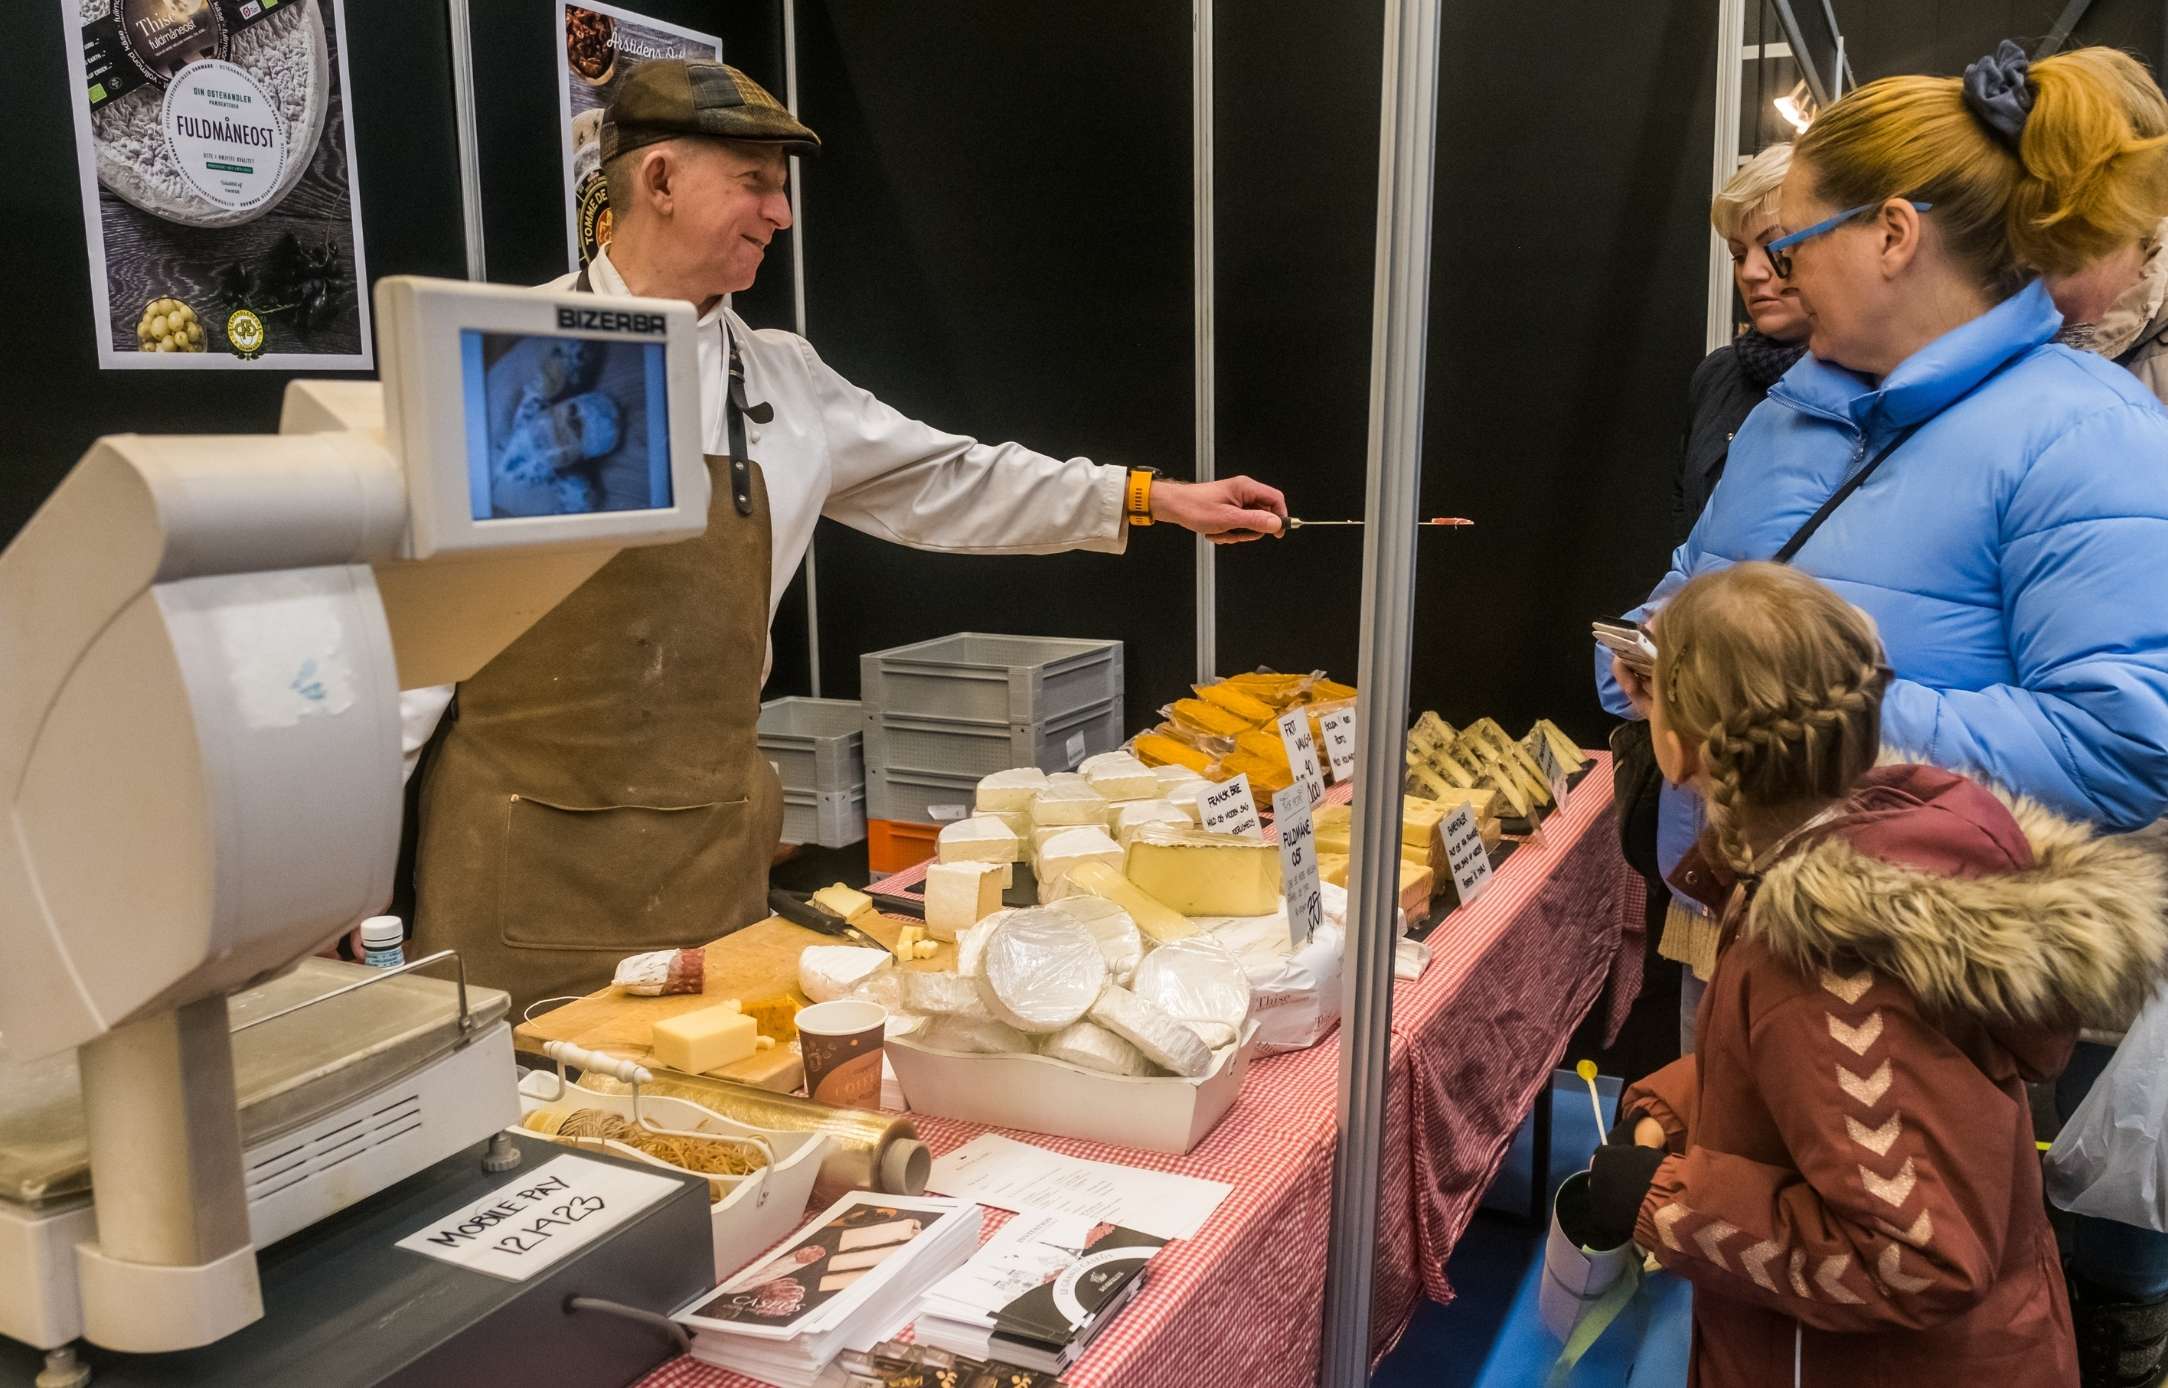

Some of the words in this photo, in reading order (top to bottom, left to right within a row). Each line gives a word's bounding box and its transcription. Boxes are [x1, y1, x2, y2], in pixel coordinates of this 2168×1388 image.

[135, 11, 177, 37] Thise
[148, 20, 197, 50] fuldmåneost
[127, 51, 158, 84] vollmond
[193, 87, 205, 96] DIN
[206, 89, 252, 104] OSTEHANDLER
[176, 115, 274, 148] FULDMÅNEOST
[584, 198, 598, 245] TOMME
[594, 187, 609, 203] DE
[427, 1199, 529, 1248] MOBILE
[516, 1175, 571, 1202] PAY
